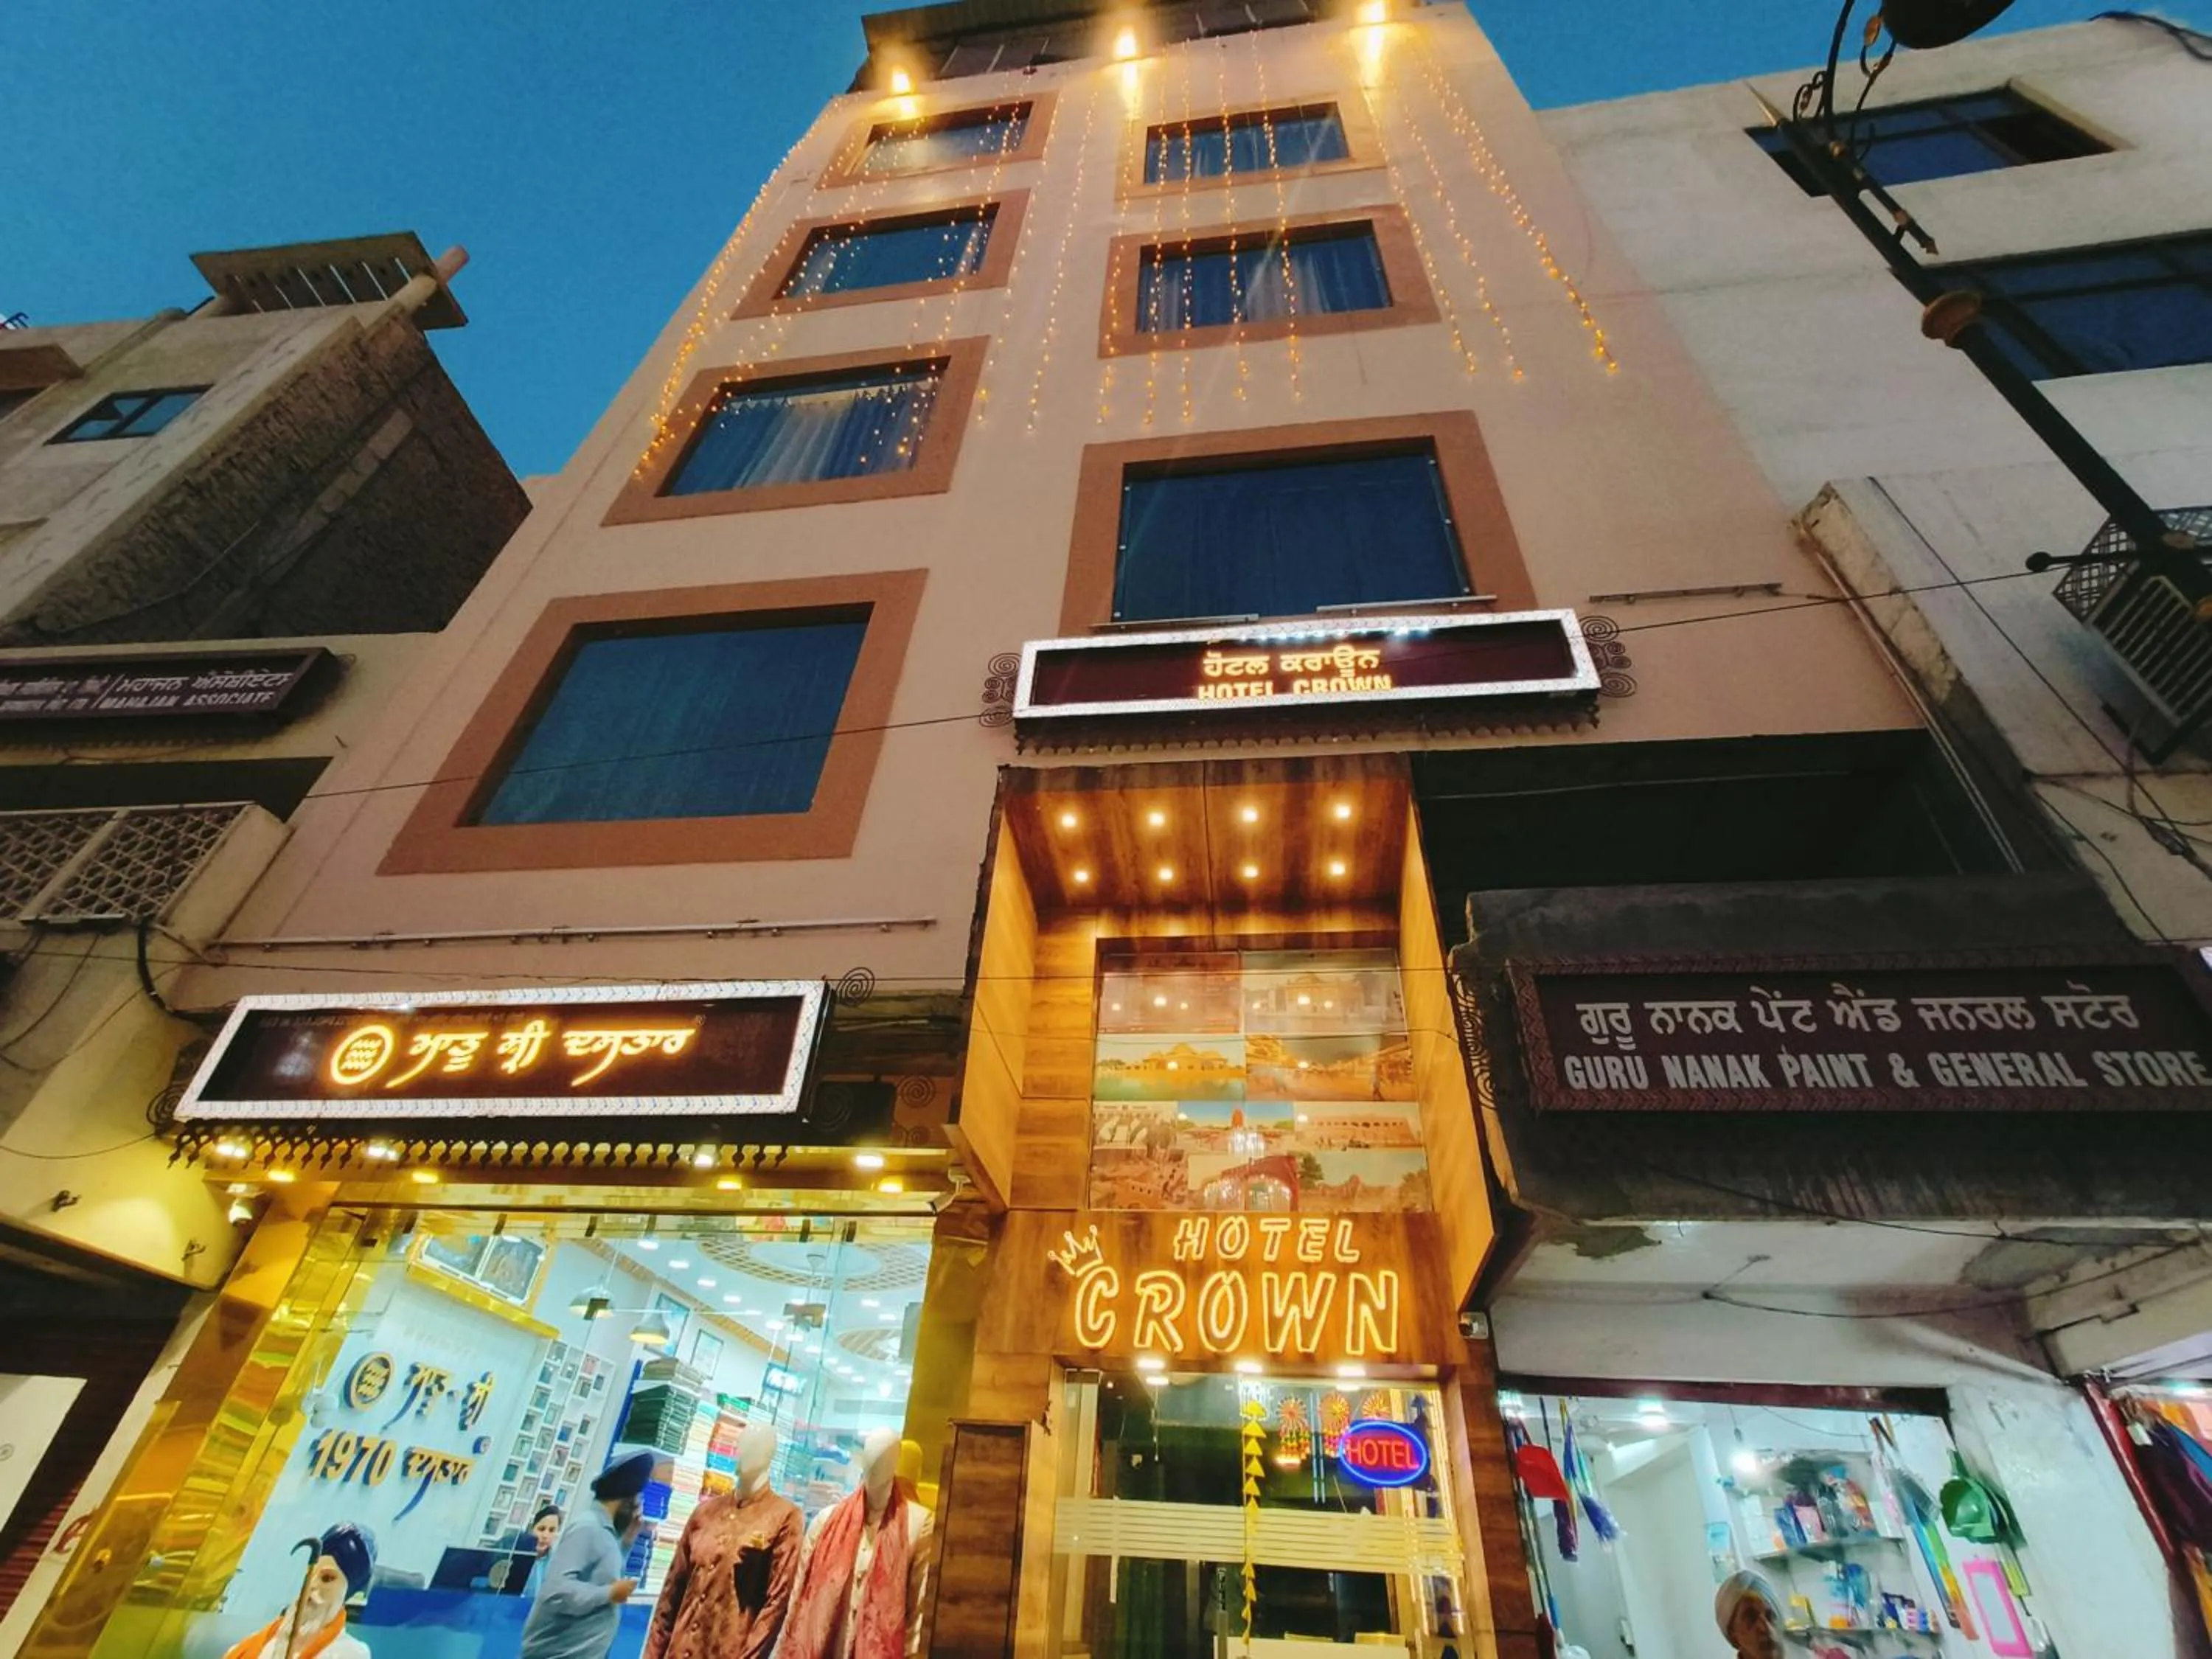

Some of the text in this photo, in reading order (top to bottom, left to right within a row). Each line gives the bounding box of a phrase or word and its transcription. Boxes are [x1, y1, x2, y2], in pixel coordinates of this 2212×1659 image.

[1203, 650, 1270, 677] ਹੋਟਲ
[1198, 675, 1392, 700] HOTEL CROWN
[1576, 1003, 1636, 1050] ਗੁਰੂ
[1644, 1001, 1743, 1034] ਨਾਨਕ
[1750, 985, 1818, 1032] ਪੇਂਟ
[1826, 982, 1902, 1032] ਐਂਡ
[1911, 995, 2036, 1032] ਜਨਰਲ
[562, 1029, 696, 1088] ਦਸਤਾਰ
[1564, 1049, 2212, 1091] GURU NANAK PAINT & GENERAL STORE
[1174, 1216, 1360, 1263] HOTEL
[1074, 1265, 1399, 1355] CROWN
[309, 1428, 397, 1486] 1970
[1346, 1438, 1419, 1470] HOTEL
